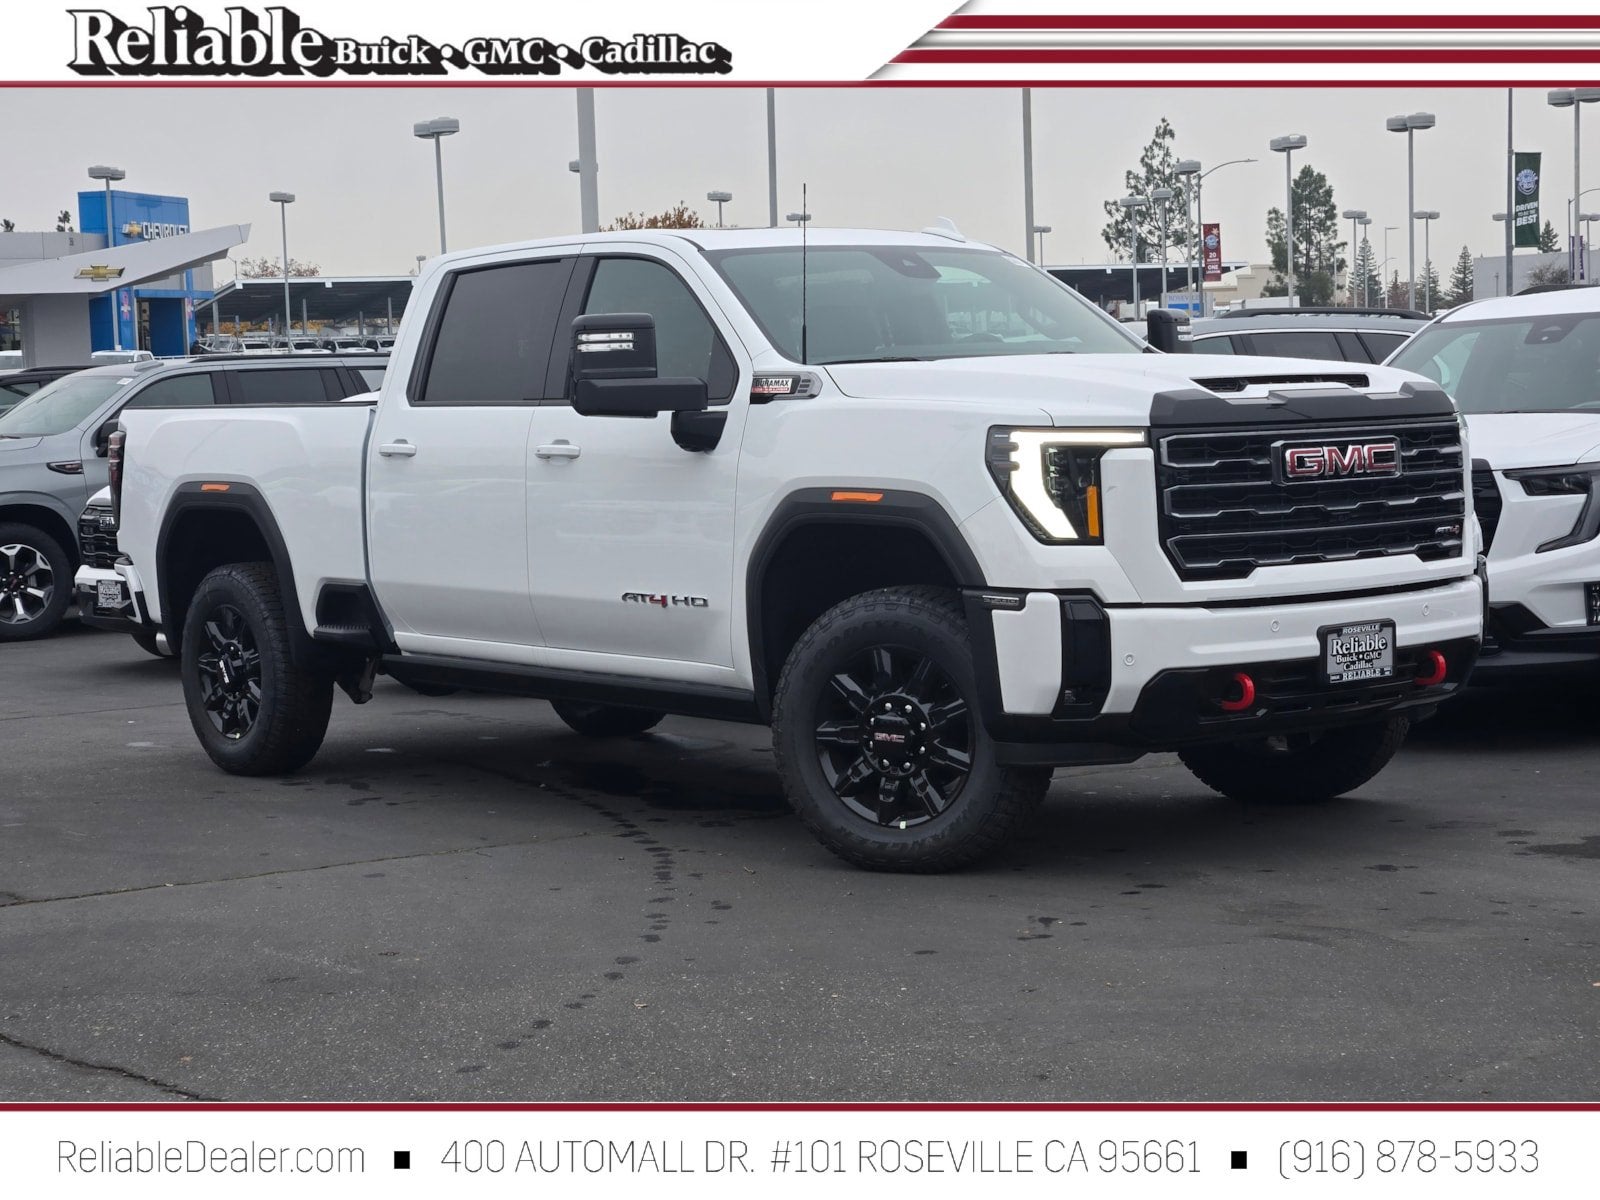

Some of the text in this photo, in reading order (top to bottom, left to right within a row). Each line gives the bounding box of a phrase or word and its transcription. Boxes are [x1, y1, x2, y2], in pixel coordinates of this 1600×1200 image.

[1516, 214, 1537, 226] BEST
[142, 221, 188, 239] CHEVROLET
[1285, 443, 1397, 478] GMC
[621, 592, 709, 608] AT4 HD
[1342, 623, 1380, 634] ROSEVILLE
[1331, 633, 1387, 656] Reliable
[1336, 651, 1382, 664] Buick GMC
[1343, 660, 1374, 671] Cadillac
[1342, 668, 1381, 681] RELIABLE
[874, 732, 905, 742] GMC
